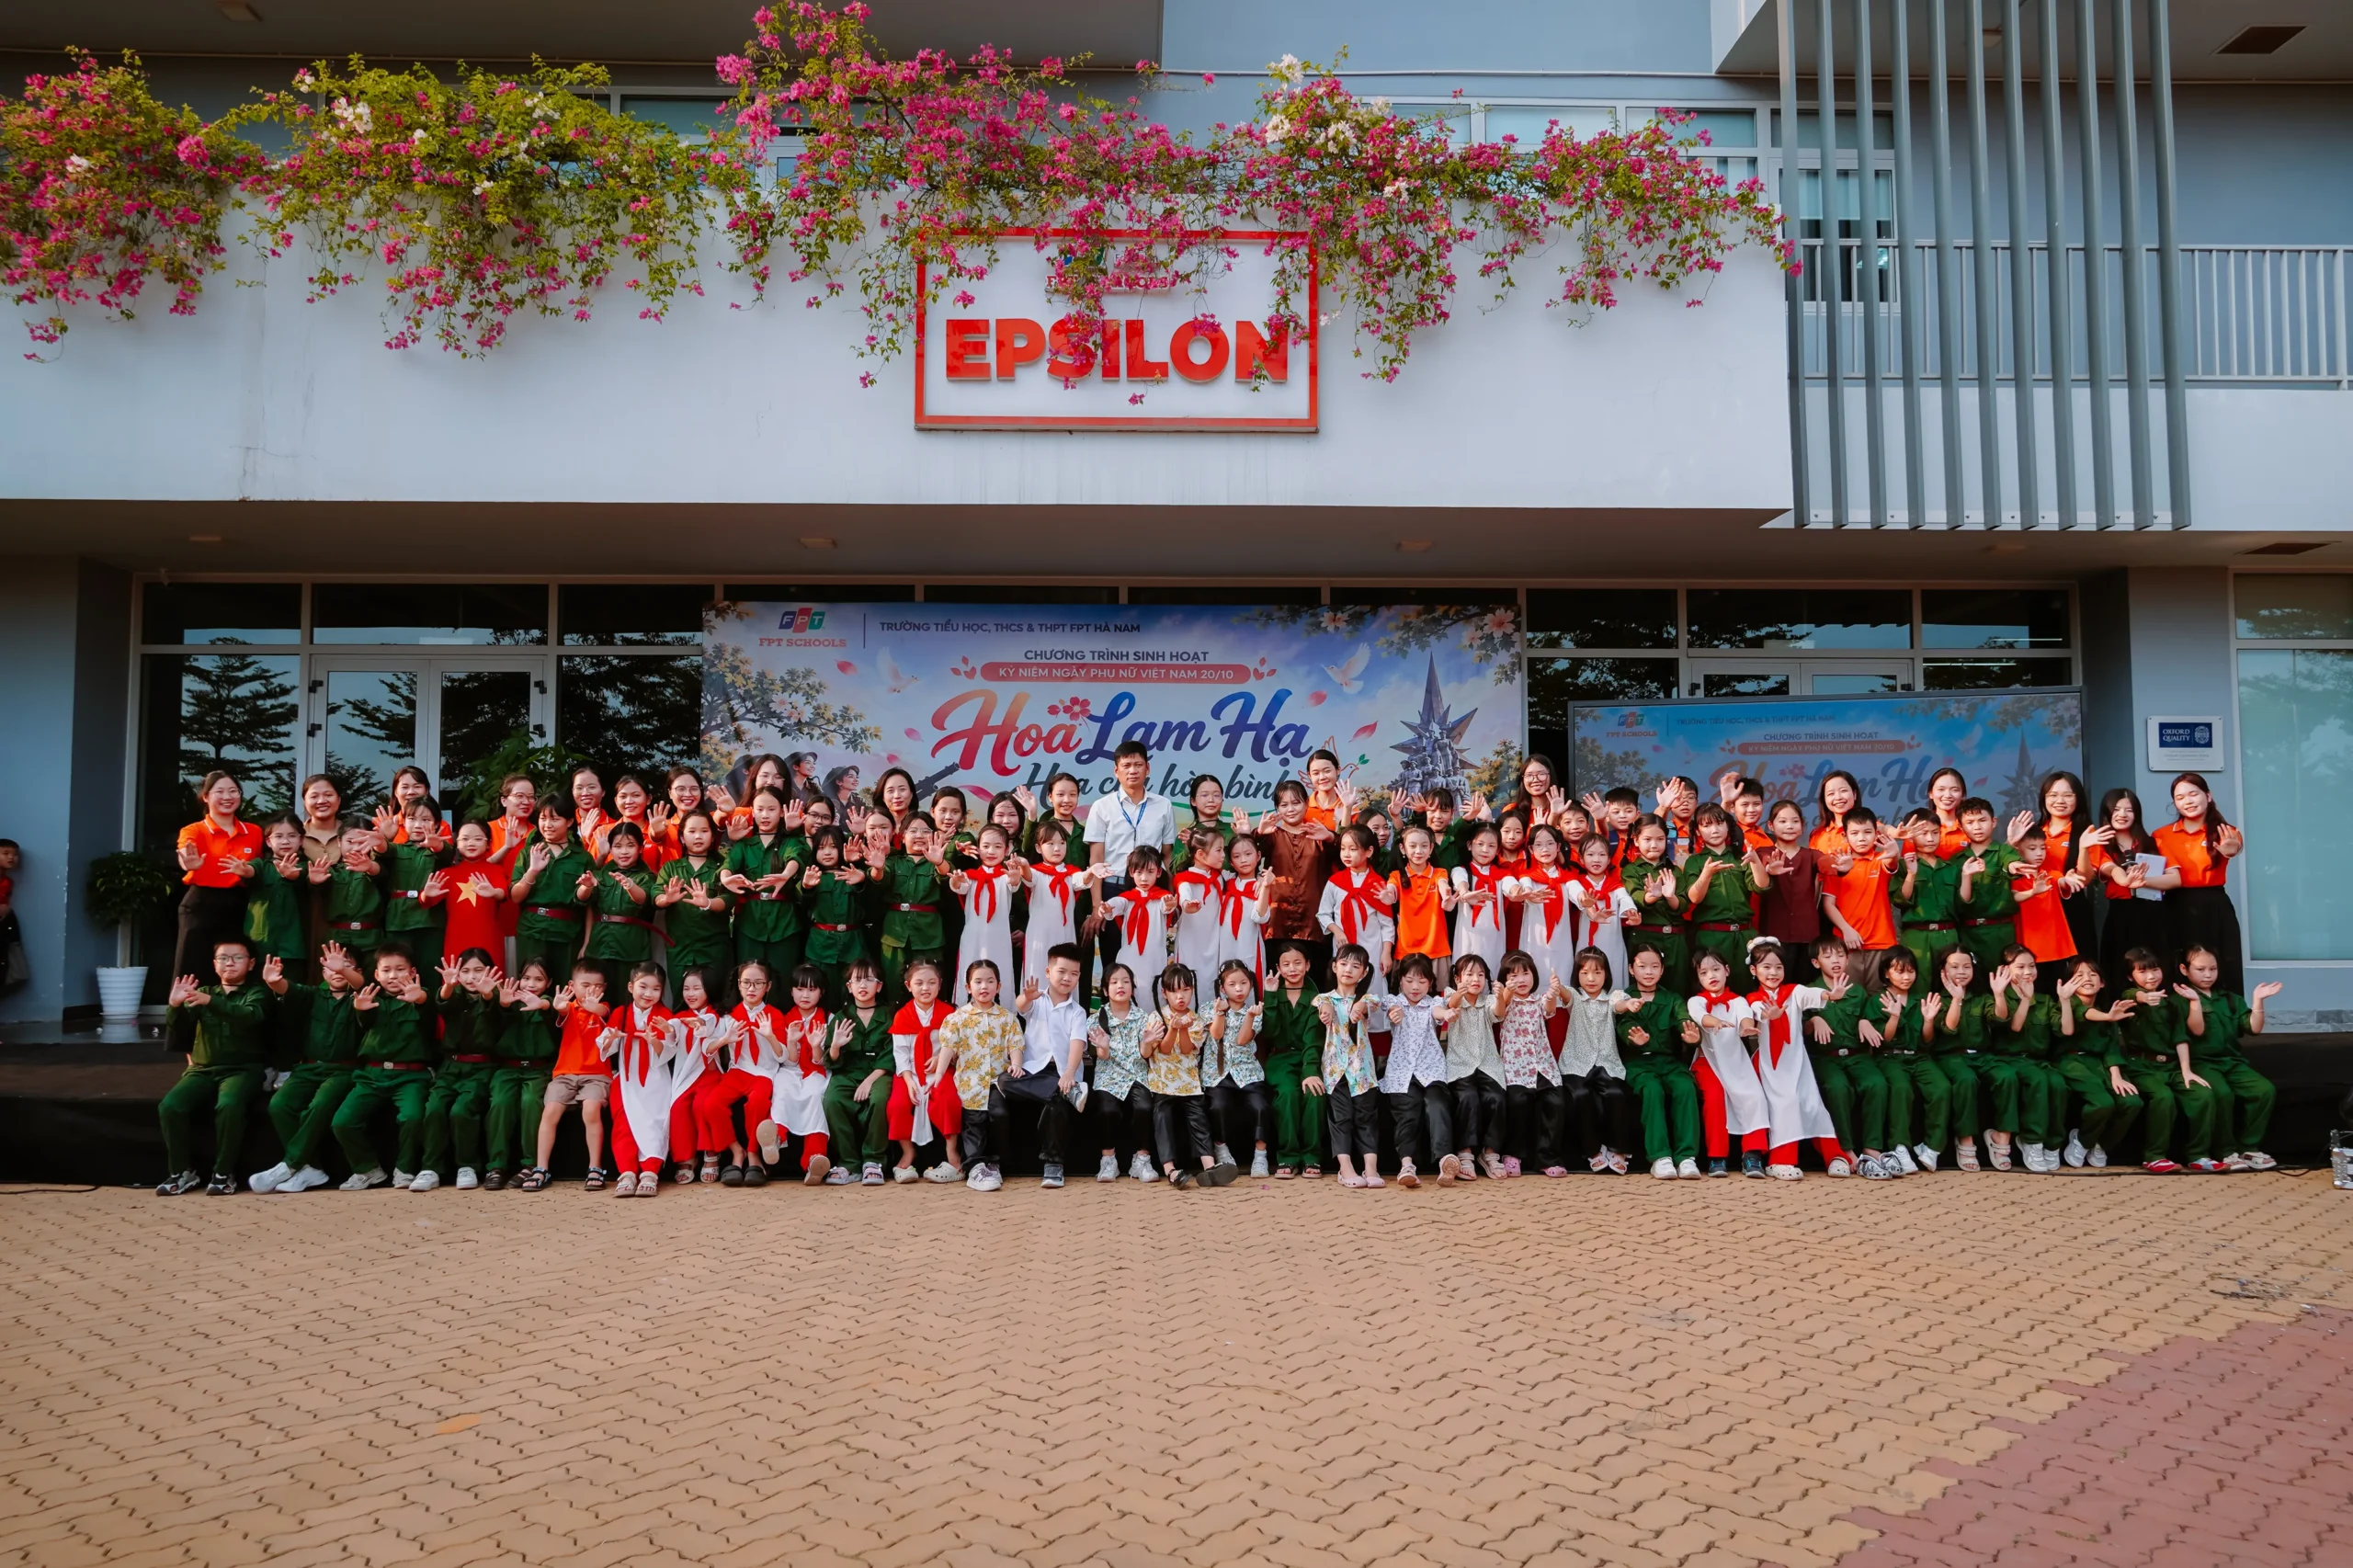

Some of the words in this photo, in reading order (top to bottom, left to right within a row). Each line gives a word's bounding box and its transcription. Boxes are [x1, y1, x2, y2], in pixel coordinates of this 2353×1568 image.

[946, 318, 1289, 382] EPSILON
[780, 611, 824, 629] FPT
[880, 620, 930, 632] TRƯỜNG
[934, 619, 960, 632] TIỂU
[962, 623, 991, 634] HỌC,
[994, 623, 1023, 632] THCS
[1027, 623, 1036, 632] &
[1039, 623, 1067, 632] THPT
[1070, 623, 1091, 632] FPT
[1094, 621, 1111, 633] HÀ
[1114, 624, 1141, 633] NAM
[759, 638, 783, 648] FPT
[786, 638, 847, 648] SCHOOLS
[1025, 648, 1086, 661] CHƯƠNG
[1089, 648, 1129, 662] TRÌNH
[1133, 651, 1165, 662] SINH
[1169, 651, 1210, 664] HOẠT
[1018, 666, 1050, 679] NIỆM
[1052, 666, 1087, 678] NGÀY
[1091, 668, 1116, 680] PHỤ
[1120, 667, 1138, 679] NỮ
[1141, 667, 1166, 680] VIỆT
[1169, 670, 1198, 679] NAM
[1200, 670, 1233, 680] 20/10
[930, 688, 1082, 777] Hoa
[1074, 691, 1211, 765] Lam
[1211, 688, 1313, 767] Hạ
[1018, 762, 1094, 811] Ha
